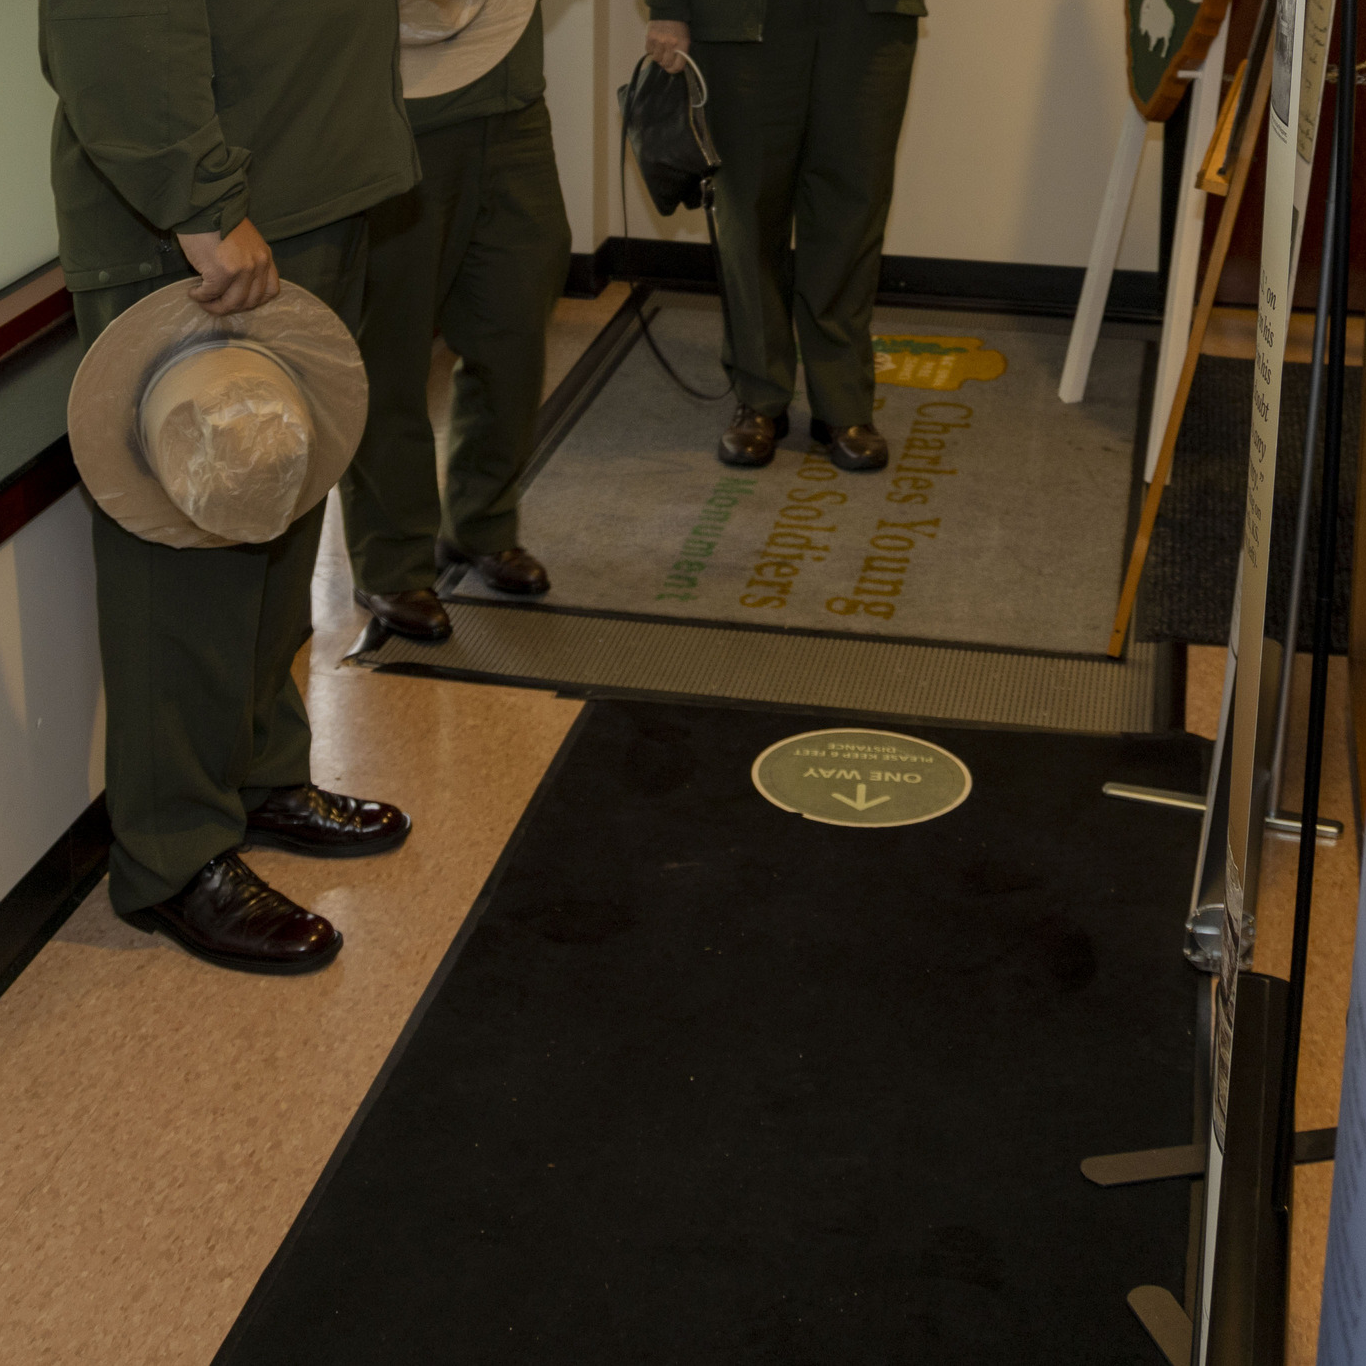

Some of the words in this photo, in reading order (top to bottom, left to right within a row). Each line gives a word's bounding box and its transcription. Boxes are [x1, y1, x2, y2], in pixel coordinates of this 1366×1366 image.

[1266, 287, 1277, 310] on
[1262, 315, 1274, 348] his
[1260, 352, 1272, 385] his
[886, 401, 974, 505] Charles
[655, 477, 759, 602] Monument
[739, 487, 849, 610] Soldiers
[825, 517, 942, 620] Young
[793, 748, 826, 757] FEET
[827, 742, 897, 754] DISTANCE
[831, 750, 839, 758] 6
[842, 751, 877, 761] KEEP
[883, 754, 933, 764] PLEASE
[803, 767, 862, 781] WAY
[869, 770, 922, 785] ONE
